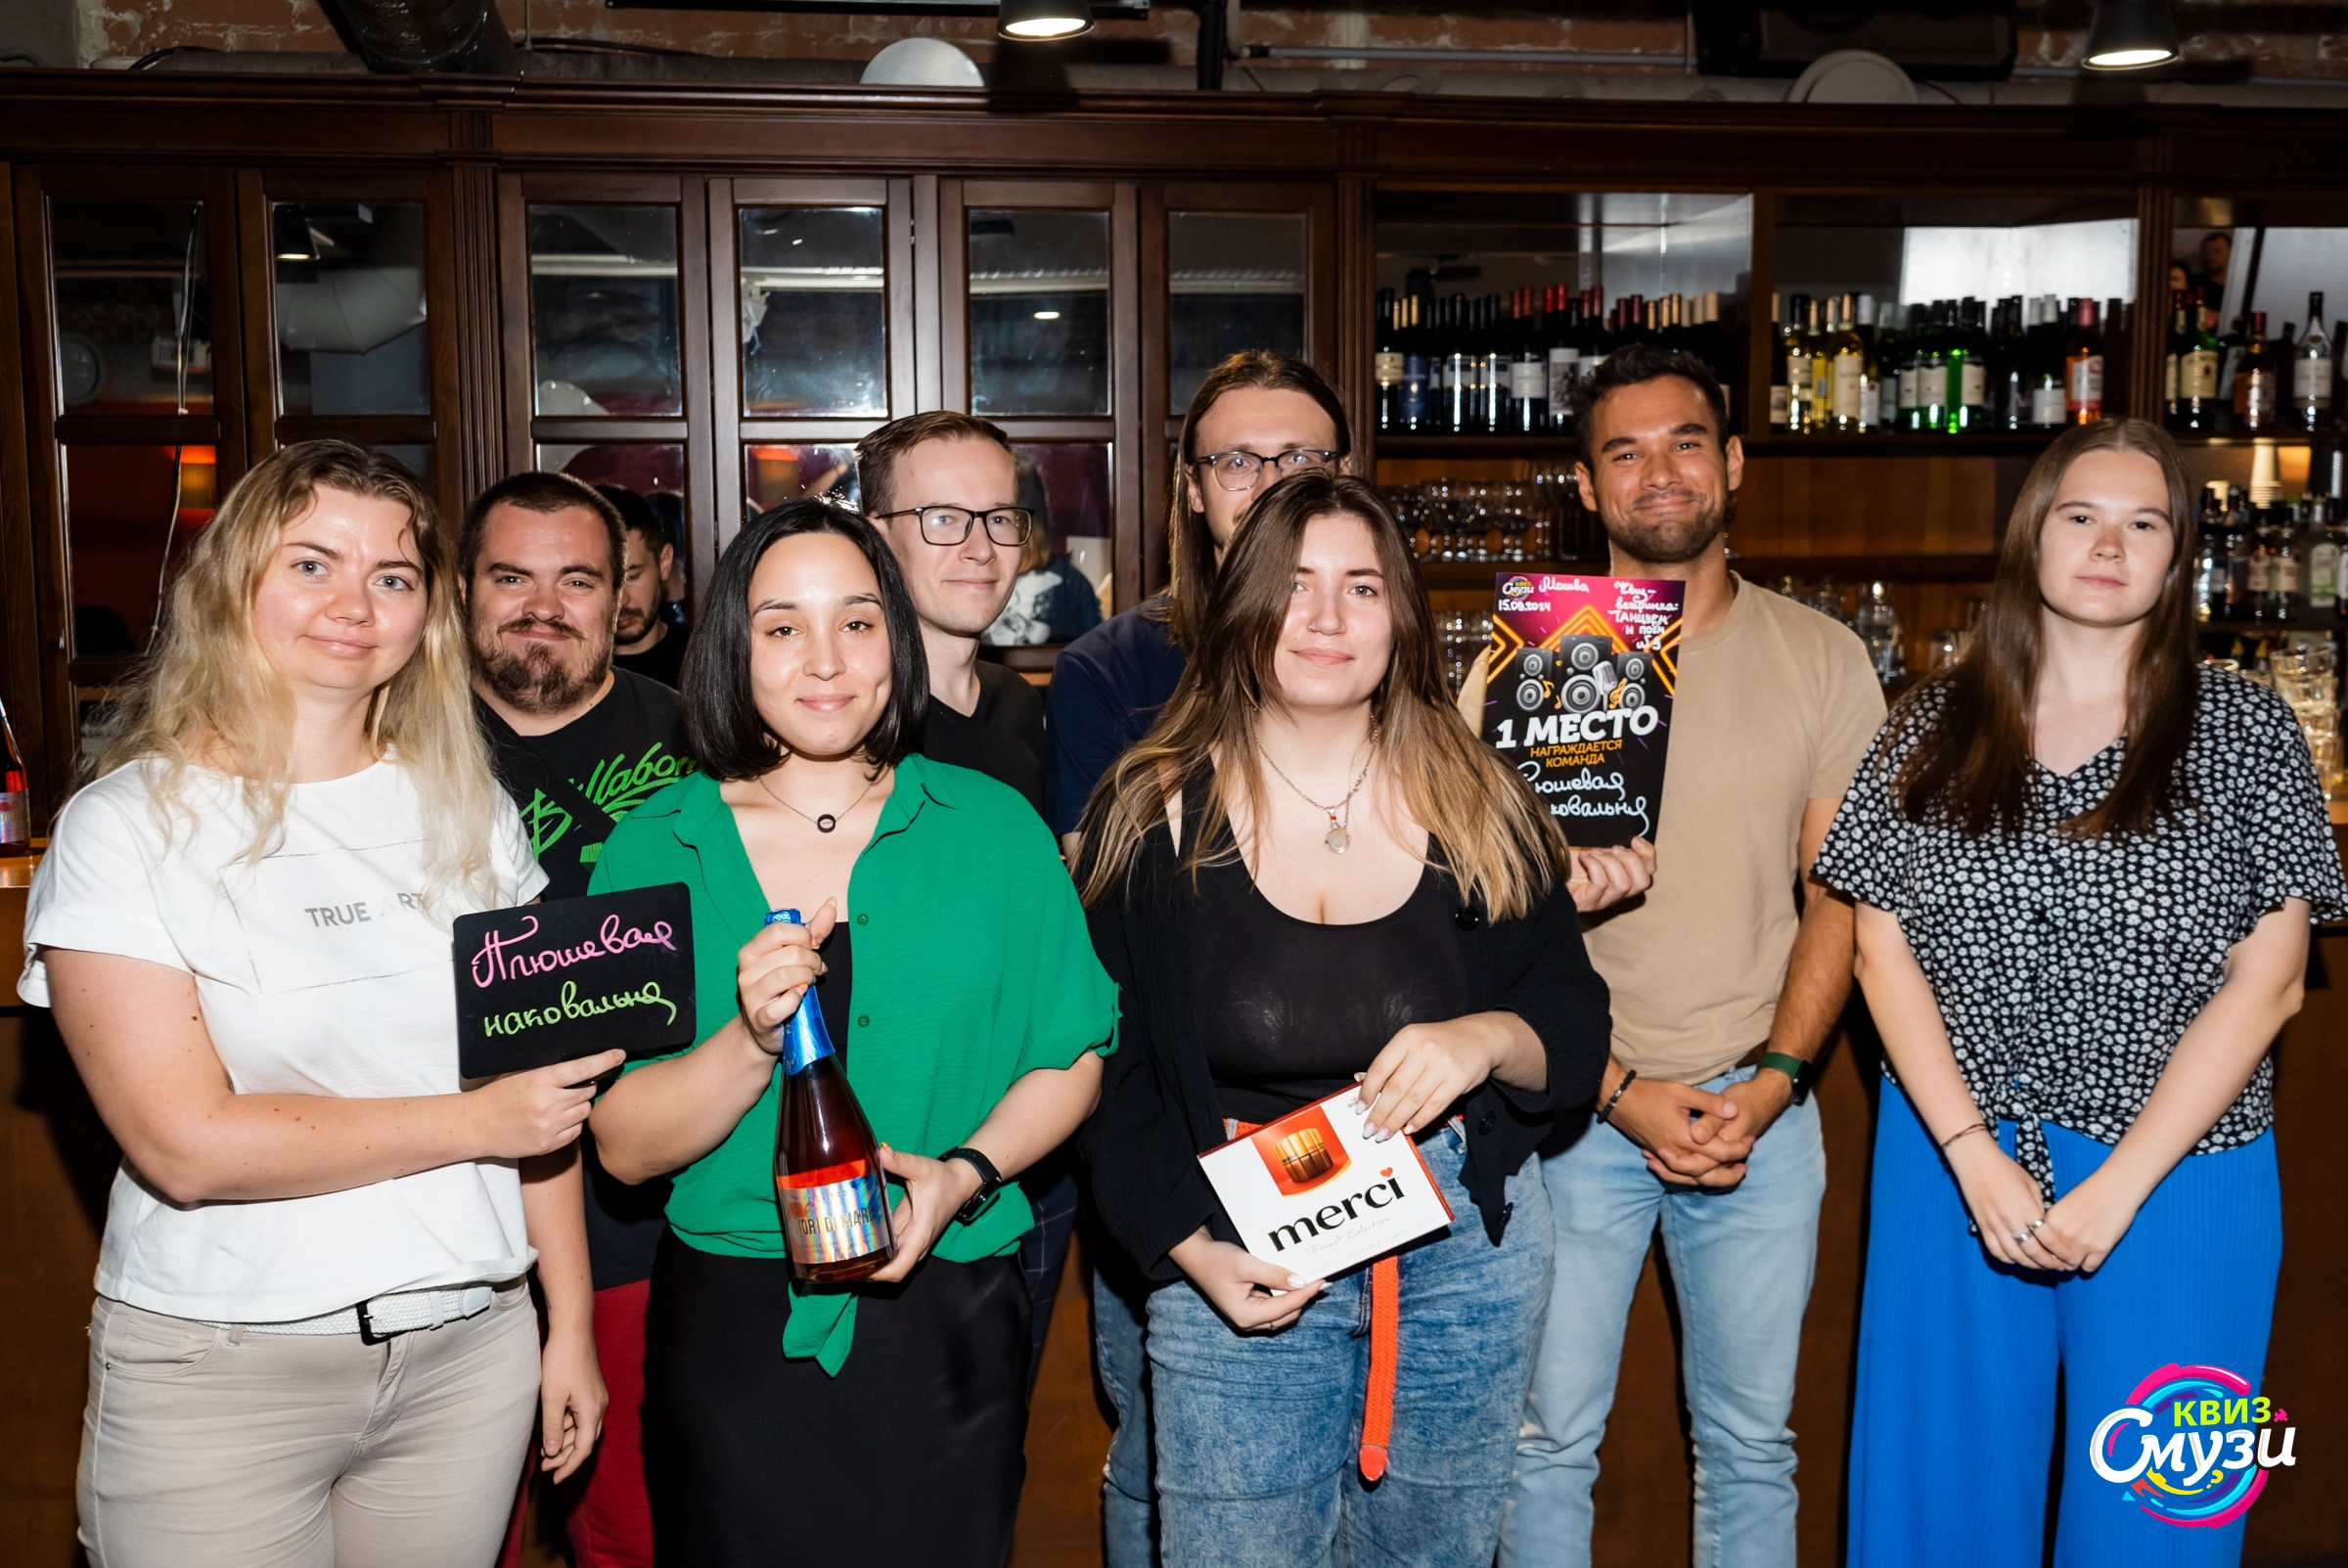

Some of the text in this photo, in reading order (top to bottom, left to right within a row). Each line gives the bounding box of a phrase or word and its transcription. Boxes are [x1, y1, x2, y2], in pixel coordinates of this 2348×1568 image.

[1495, 705, 1659, 748] 1 МЕСТО
[1530, 739, 1623, 757] НАГРАЖДАЕТСЯ
[1545, 753, 1605, 768] КОМАНДА
[304, 902, 371, 927] TRUE
[472, 915, 677, 988] Плюшевая
[483, 980, 677, 1037] наковальня
[824, 1215, 838, 1232] DI
[1268, 1176, 1405, 1252] merci
